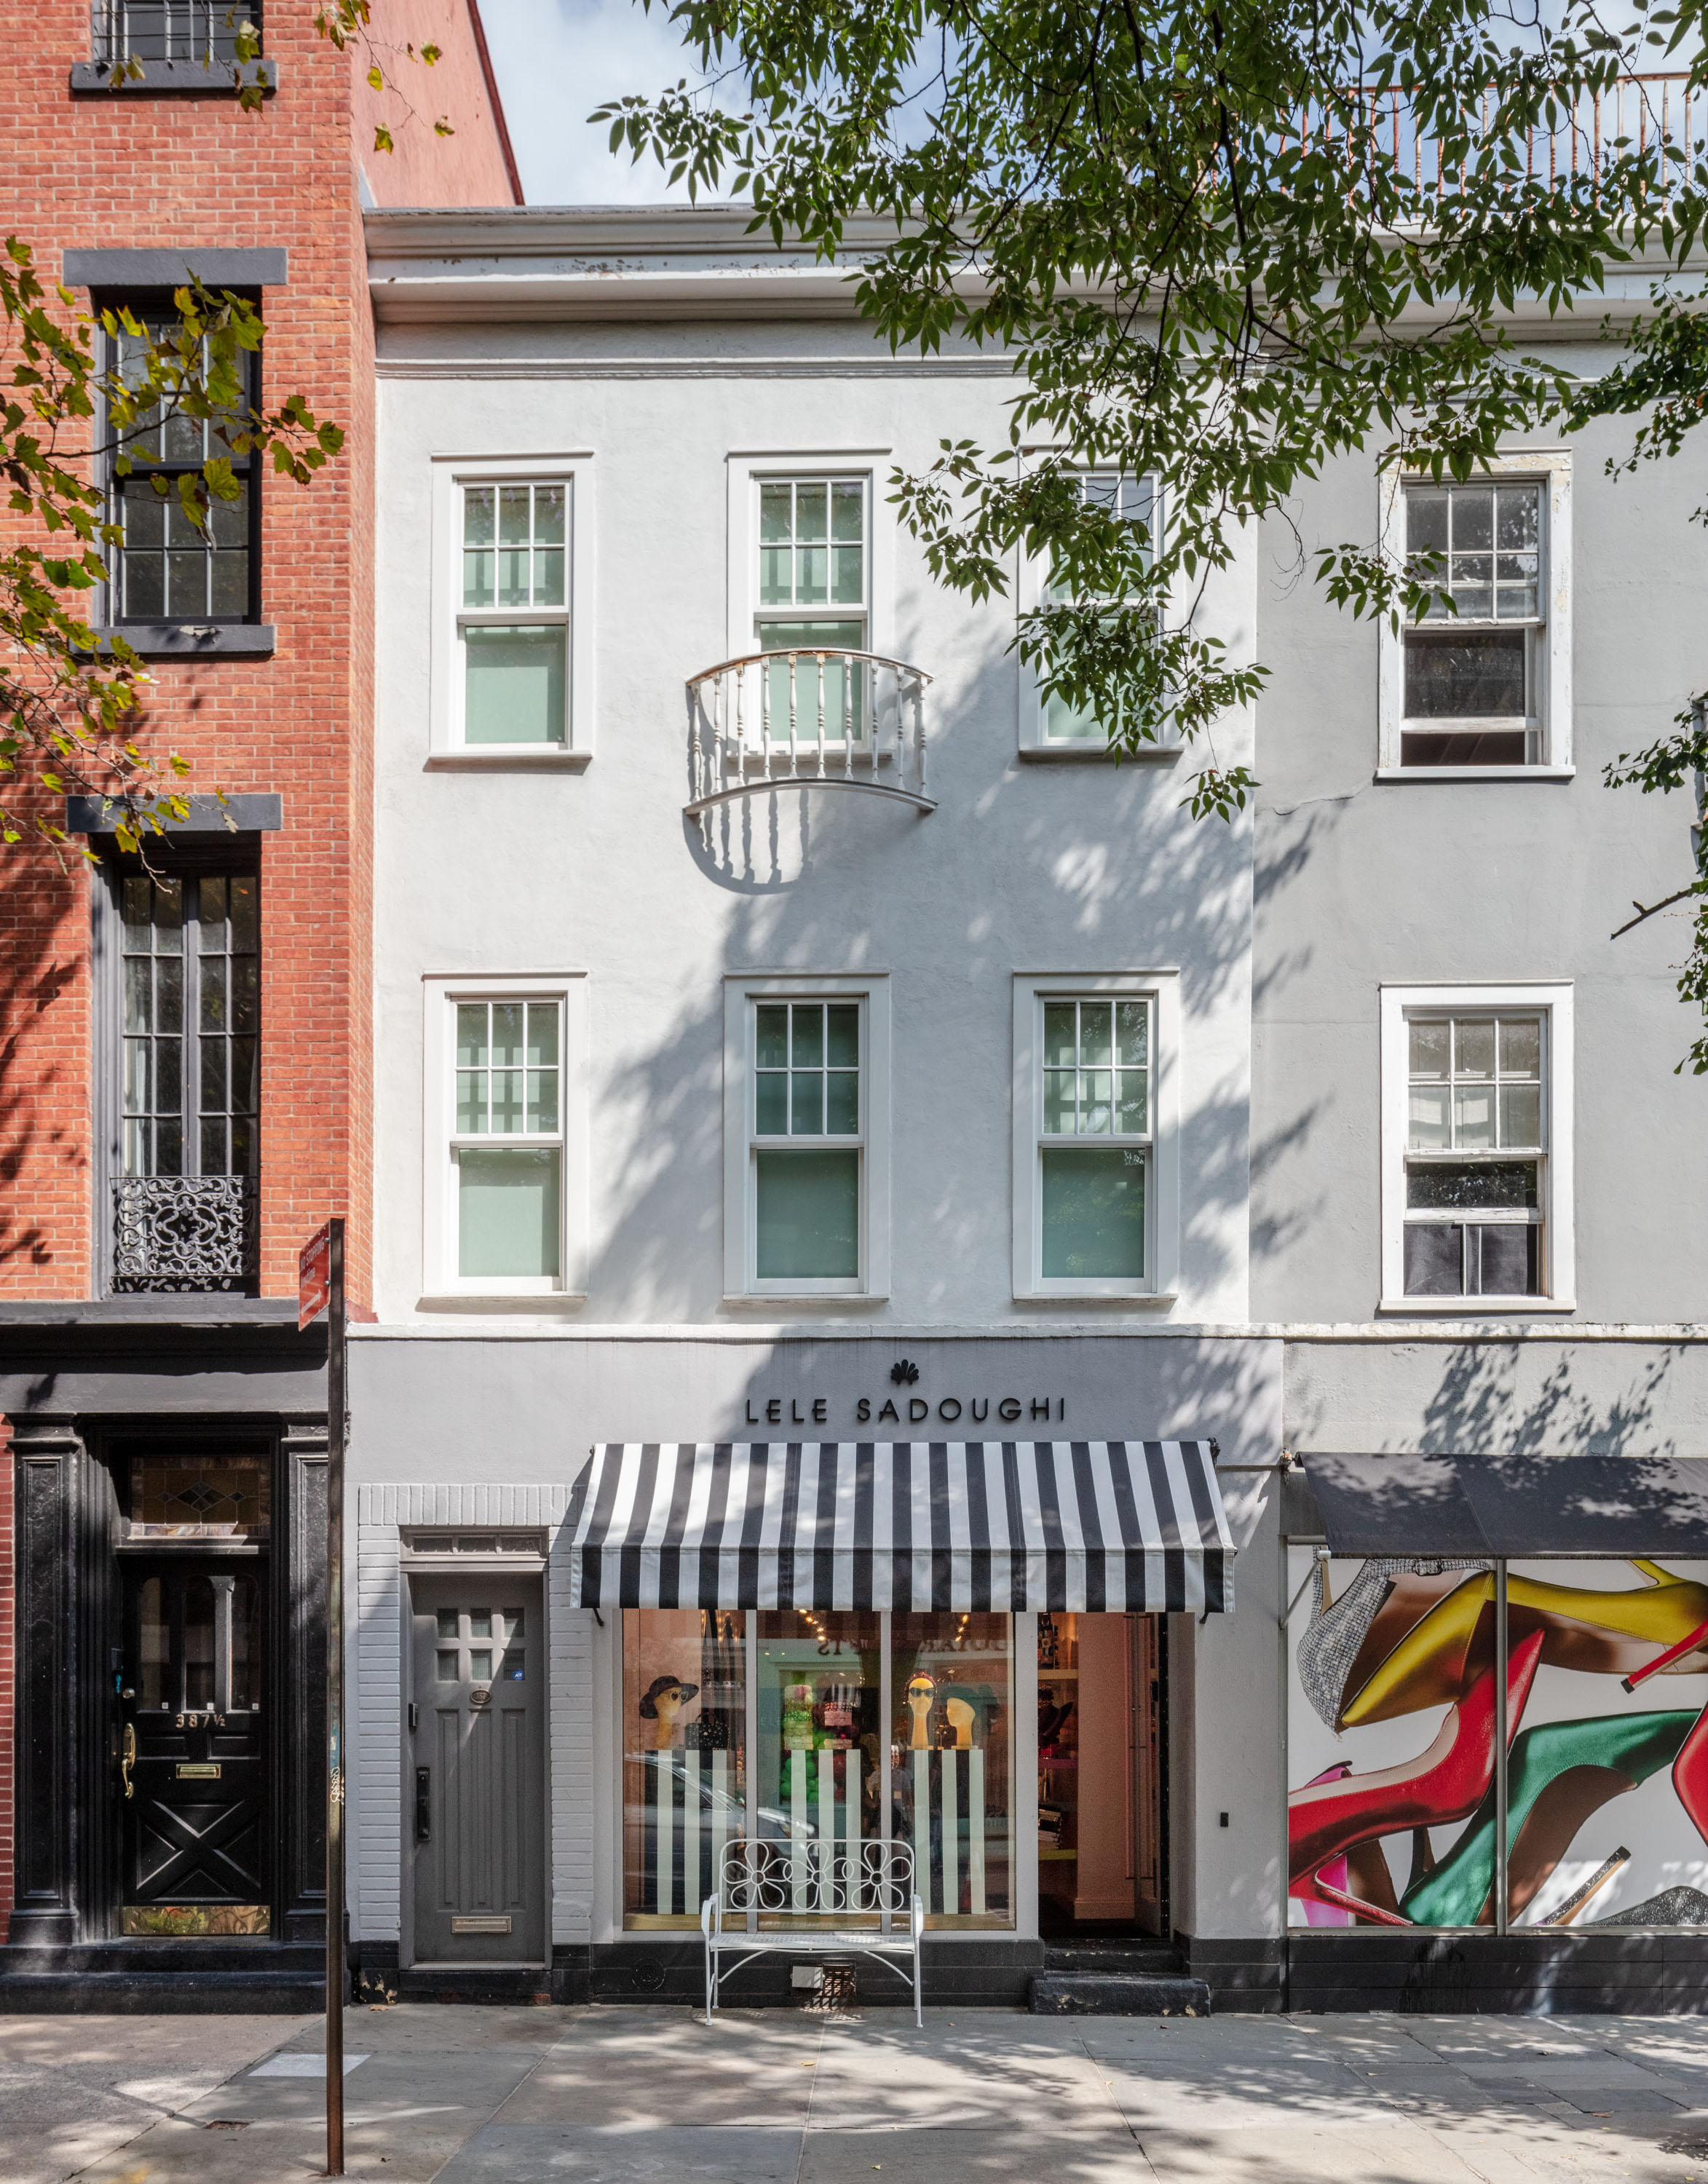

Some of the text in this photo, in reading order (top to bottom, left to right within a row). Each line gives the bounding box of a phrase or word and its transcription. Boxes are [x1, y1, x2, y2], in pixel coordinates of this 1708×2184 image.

[301, 1237, 324, 1272] NO STOPPING
[746, 1397, 1065, 1423] LELE SADOUGHI
